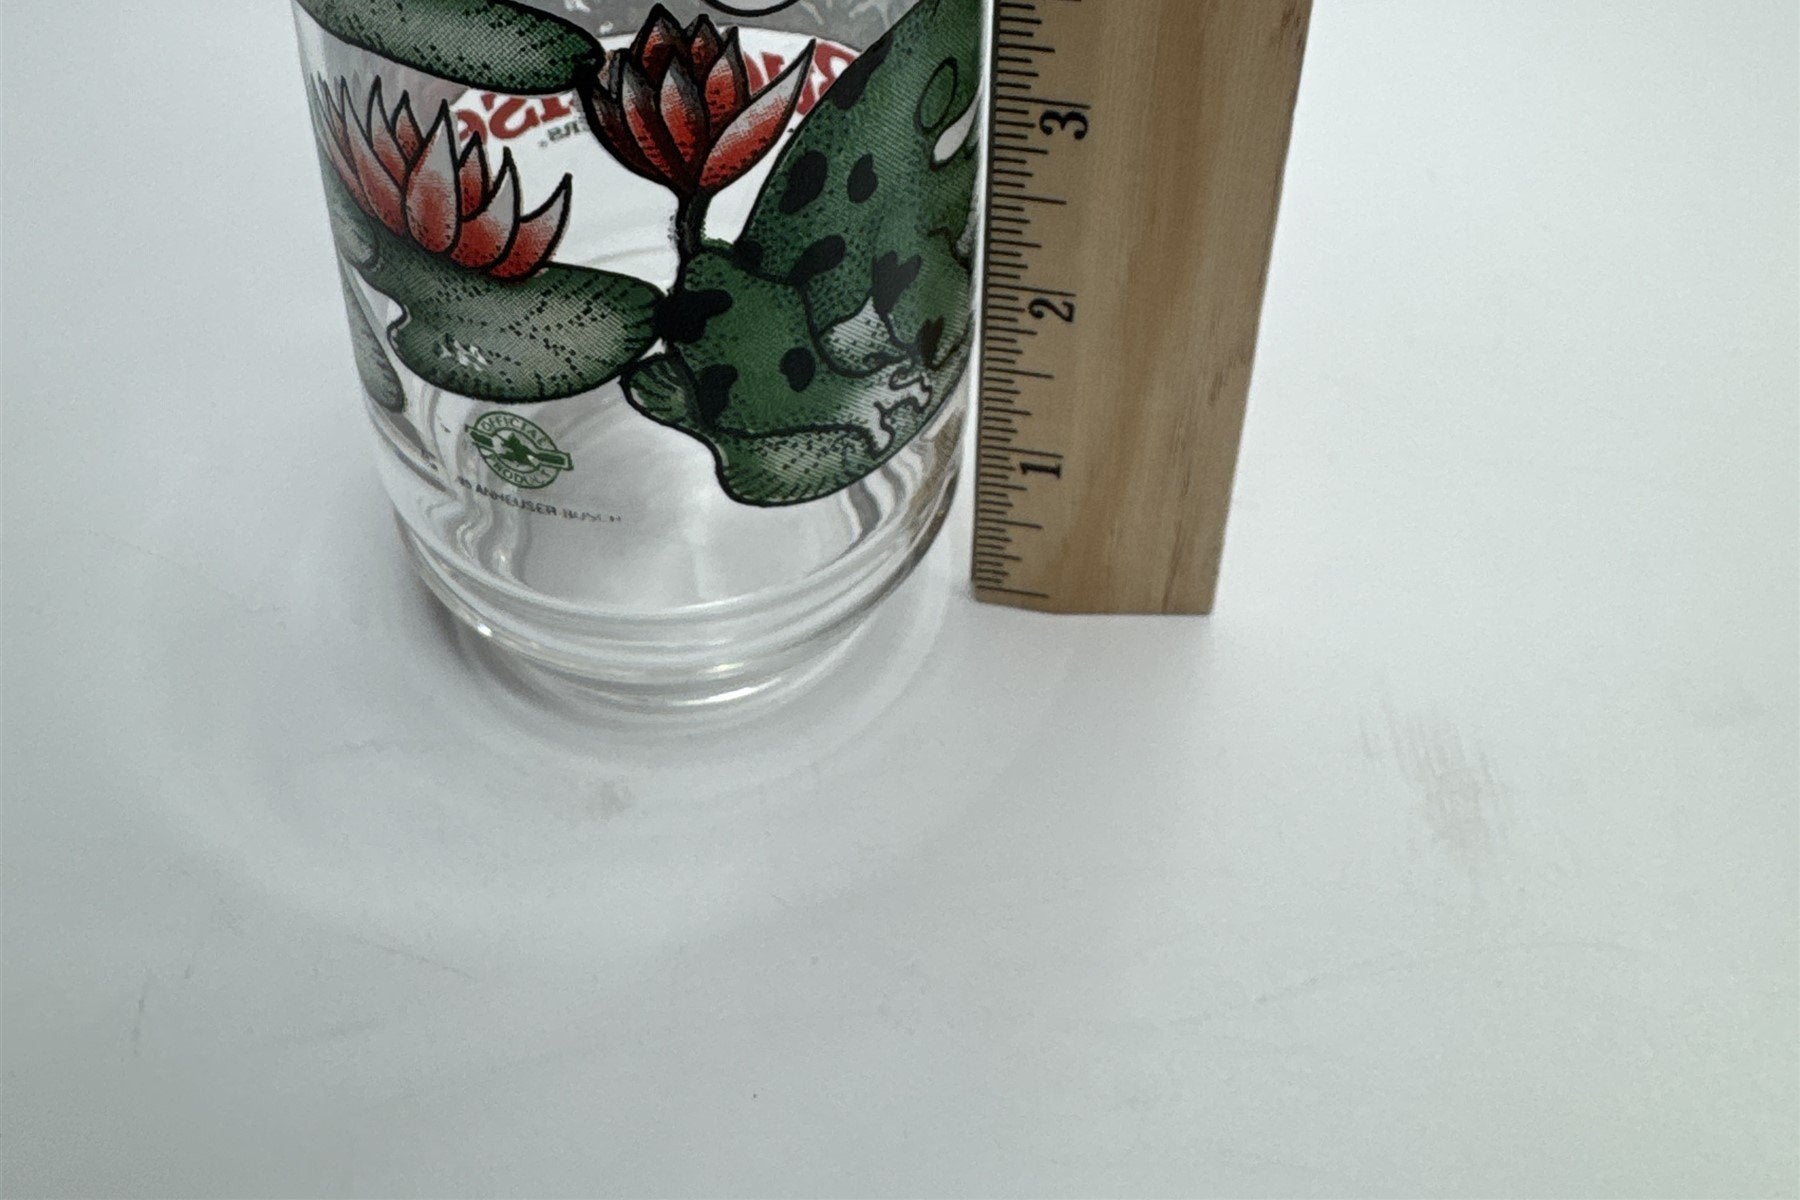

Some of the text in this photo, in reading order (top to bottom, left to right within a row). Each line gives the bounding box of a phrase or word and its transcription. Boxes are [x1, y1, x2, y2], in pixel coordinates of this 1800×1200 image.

[1039, 110, 1090, 140] 3
[1028, 296, 1076, 323] 2
[480, 414, 549, 447] OFFICIAL
[1019, 459, 1063, 480] 1
